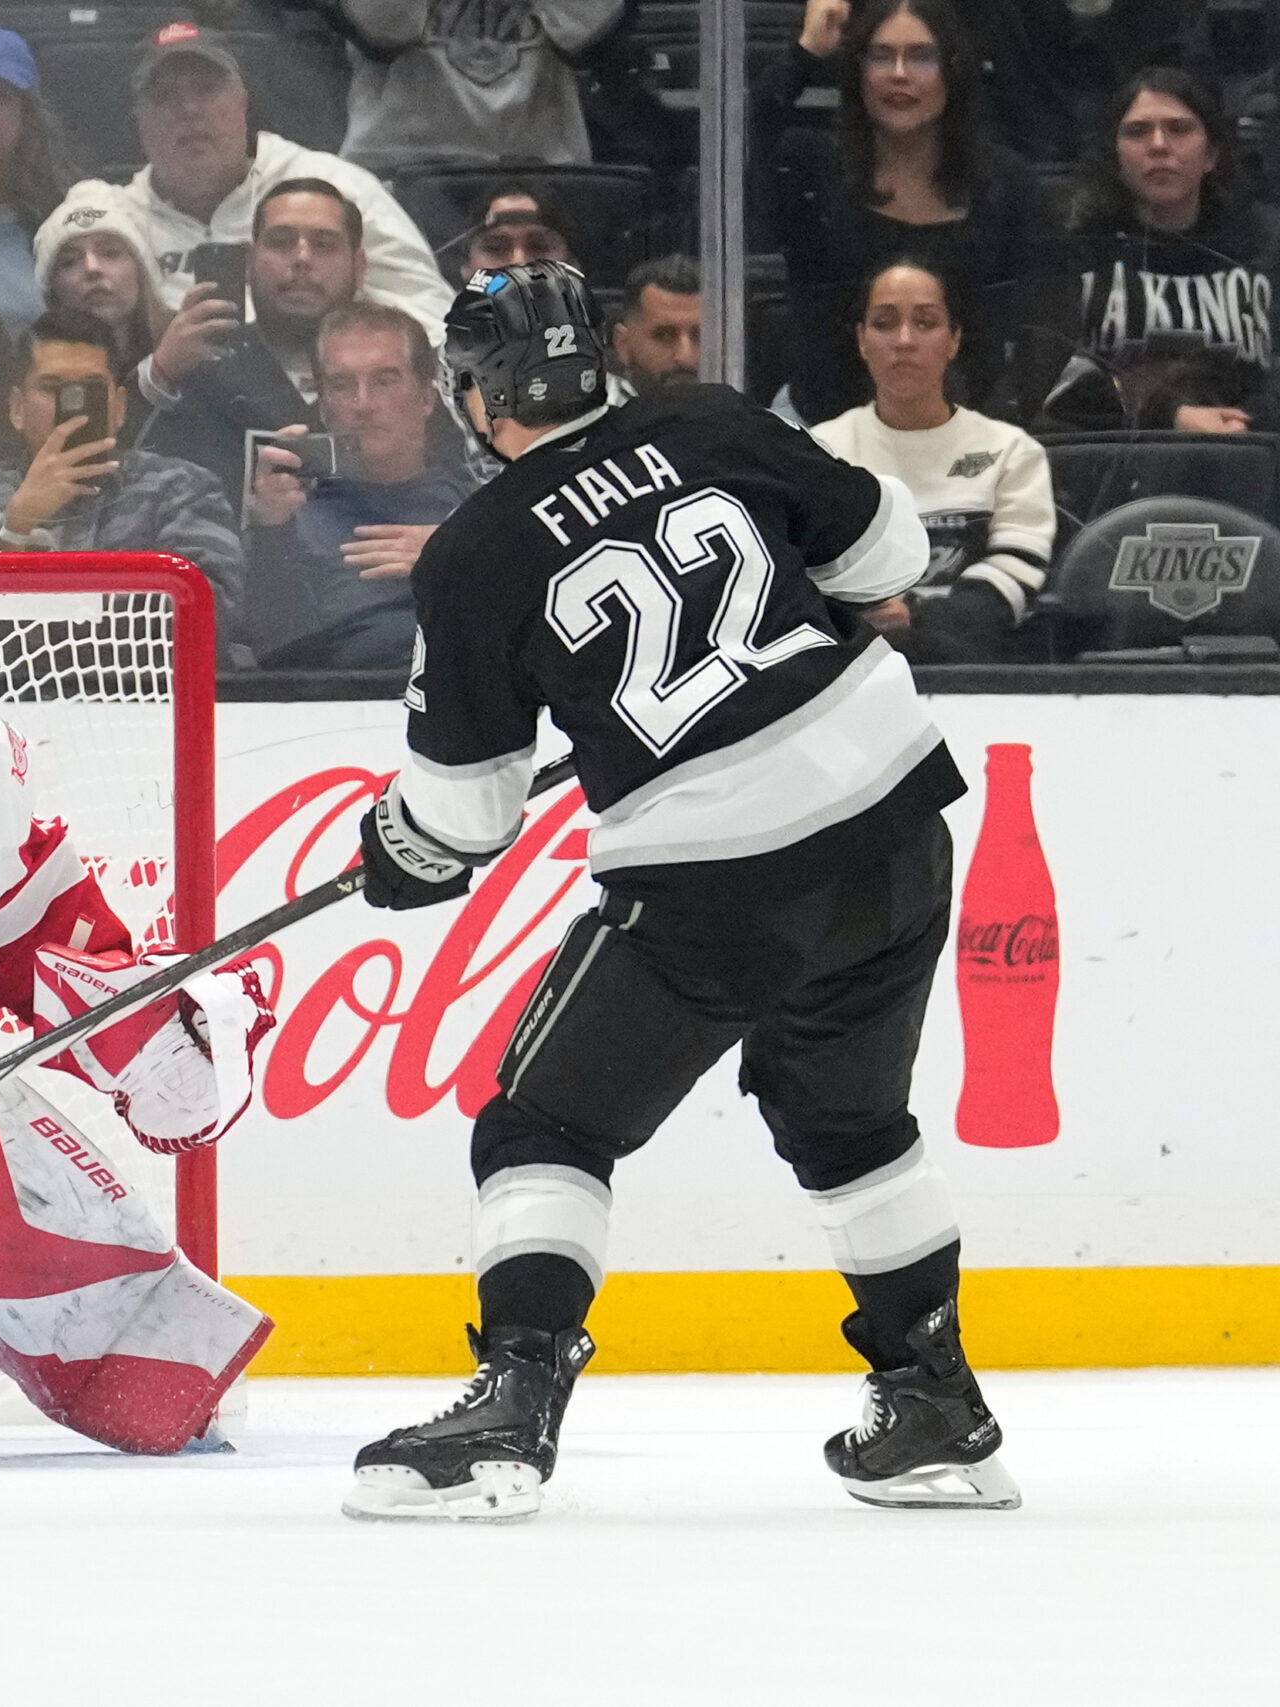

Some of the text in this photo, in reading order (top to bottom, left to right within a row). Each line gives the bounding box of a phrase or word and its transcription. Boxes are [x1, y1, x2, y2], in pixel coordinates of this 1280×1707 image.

[544, 324, 578, 358] 22
[1138, 267, 1271, 370] KINGS
[531, 443, 682, 546] FIALA
[1126, 545, 1247, 583] KINGS
[545, 486, 838, 759] 22
[377, 798, 453, 876] AUER
[54, 961, 119, 998] BAUER
[515, 986, 554, 1056] BAUER
[29, 1116, 128, 1204] BAUER
